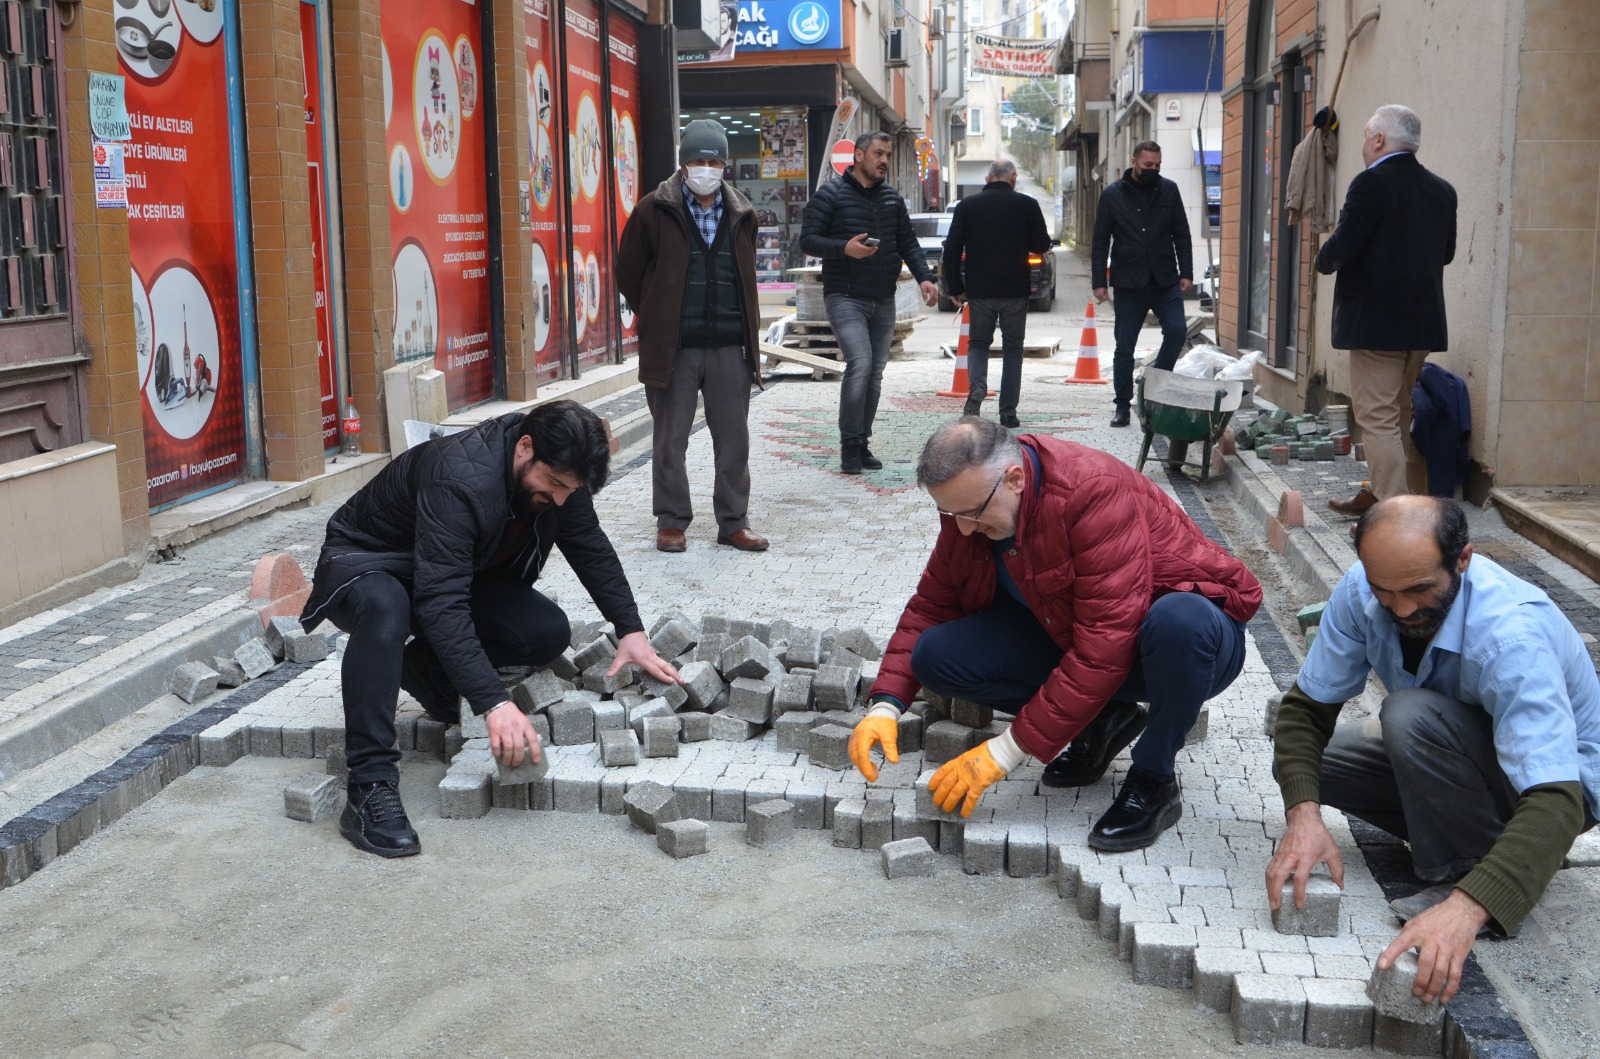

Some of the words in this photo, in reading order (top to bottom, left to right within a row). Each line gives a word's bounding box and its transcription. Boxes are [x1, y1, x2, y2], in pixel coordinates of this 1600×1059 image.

[735, 25, 778, 48] CAĞI
[96, 107, 112, 120] ÇÖP
[143, 115, 154, 130] EV
[156, 117, 194, 134] ALETLERİ
[145, 142, 187, 162] ÜRÜNLERİ
[127, 203, 141, 219] AK
[143, 201, 184, 222] ÇEŞİTLERİ
